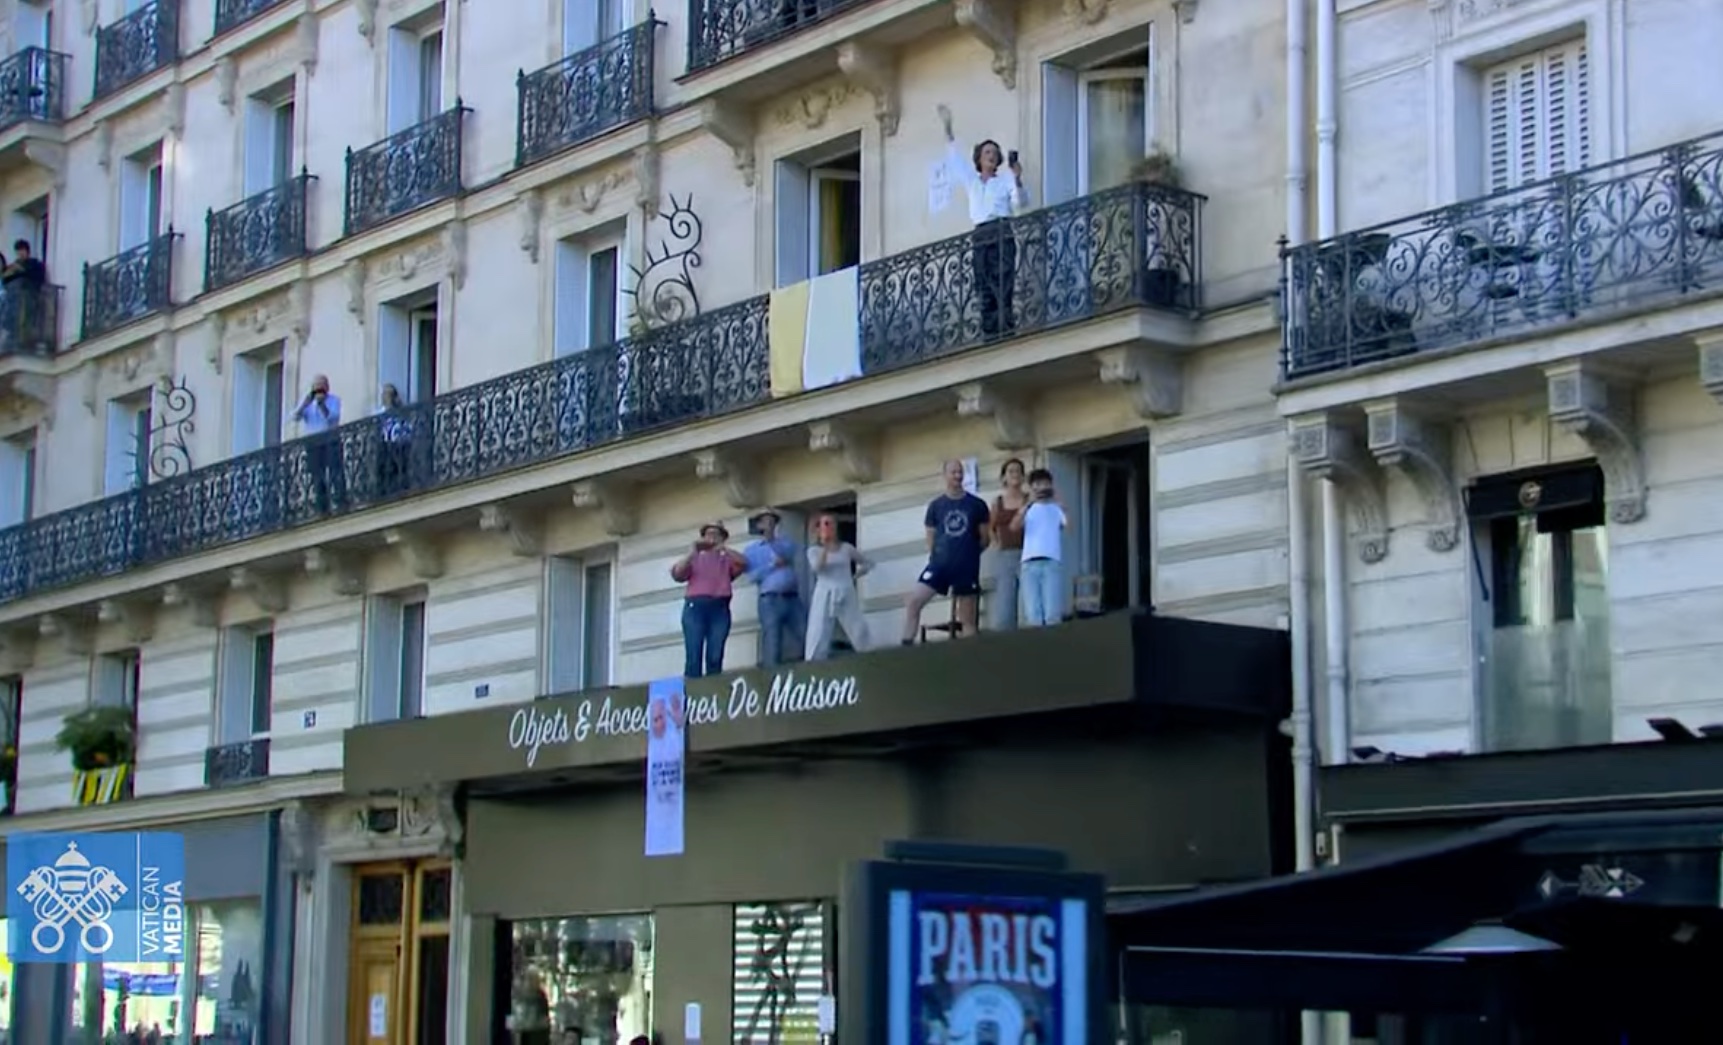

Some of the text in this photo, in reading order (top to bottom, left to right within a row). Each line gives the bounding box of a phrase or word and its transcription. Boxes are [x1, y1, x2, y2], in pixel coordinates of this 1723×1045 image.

[509, 670, 858, 768] Objets & Accesres De Maison
[917, 911, 1056, 988] PARIS
